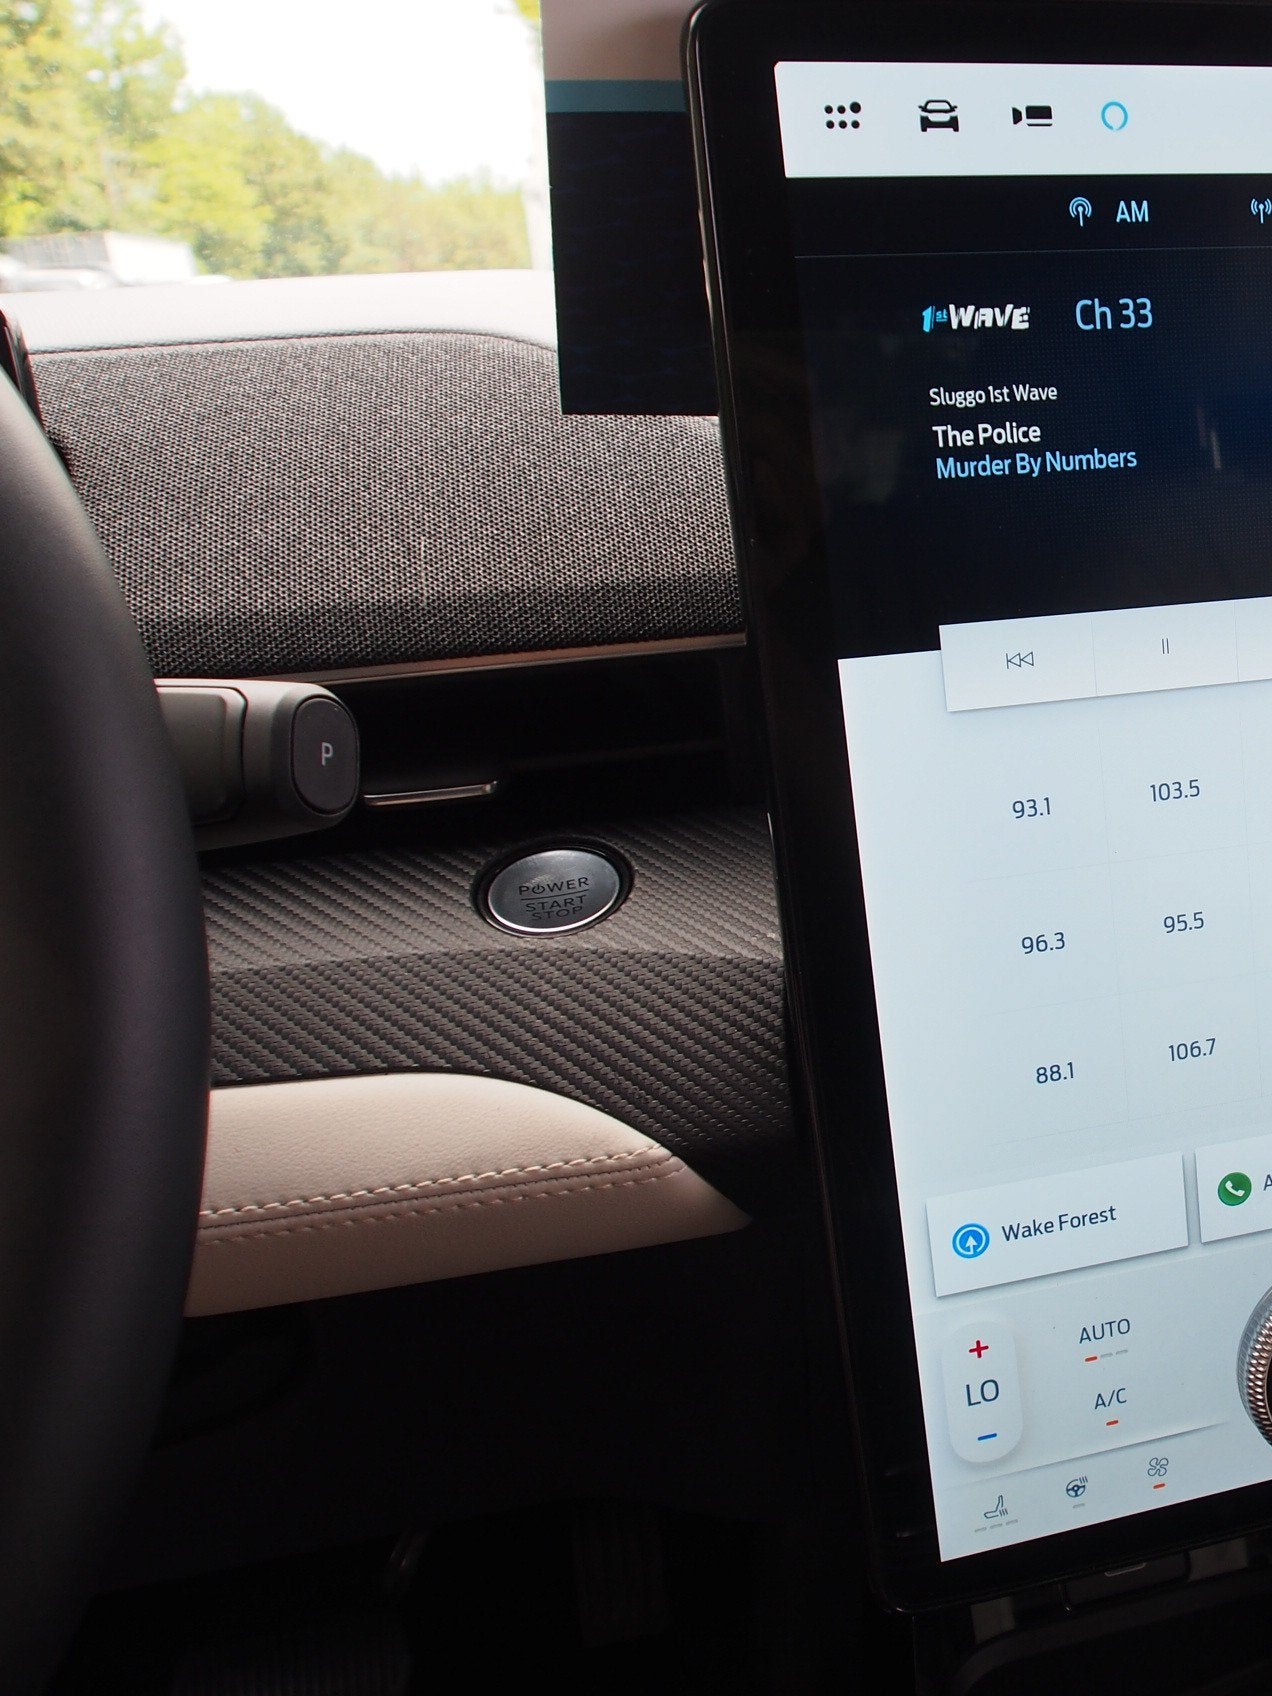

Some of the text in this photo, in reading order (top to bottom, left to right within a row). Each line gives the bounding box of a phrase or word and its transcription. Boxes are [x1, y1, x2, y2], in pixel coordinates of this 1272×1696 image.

[1116, 200, 1149, 223] AM
[1075, 298, 1154, 330] Ch 33
[929, 384, 1058, 409] Sluggo 1st Wave
[932, 421, 1041, 448] The Police
[936, 448, 1138, 479] Murder By Numbers
[321, 742, 333, 766] P
[1149, 779, 1201, 802] 103.5
[1011, 797, 1052, 819] 93.1
[519, 876, 589, 895] POWER
[525, 895, 587, 912] START
[531, 905, 583, 921] STOP
[1163, 911, 1206, 934] 95.5
[1021, 931, 1066, 955] 96.3
[1168, 1037, 1217, 1062] 106.7
[1035, 1061, 1075, 1085] 88.1
[1001, 1205, 1117, 1243] Wake Forest
[1078, 1318, 1132, 1344] AUTO
[965, 1379, 1000, 1407] LO
[1094, 1387, 1128, 1410] A/C
